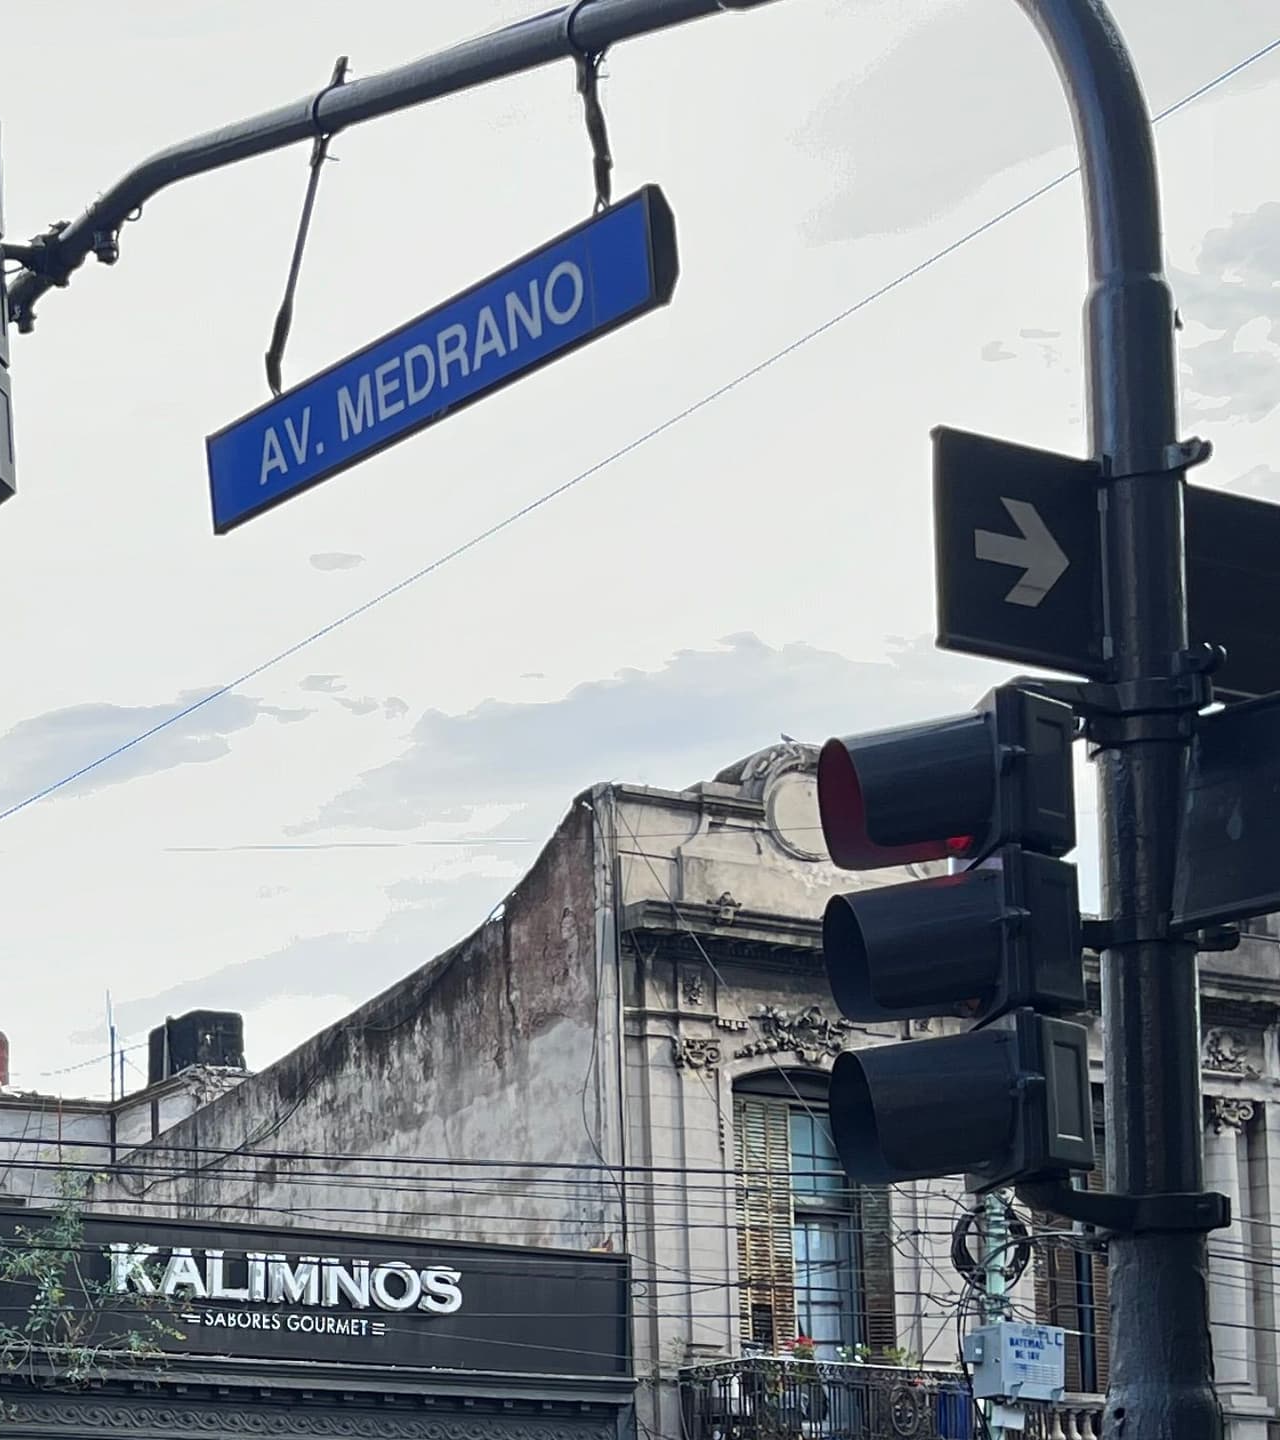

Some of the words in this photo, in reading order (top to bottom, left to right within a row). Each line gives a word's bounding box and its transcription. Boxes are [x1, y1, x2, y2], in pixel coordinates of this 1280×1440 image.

[259, 407, 324, 485] AV.
[337, 261, 584, 442] MEDRANO
[109, 1243, 463, 1314] KALIMNOS
[205, 1310, 281, 1330] SABORES
[287, 1314, 369, 1337] GOURMET
